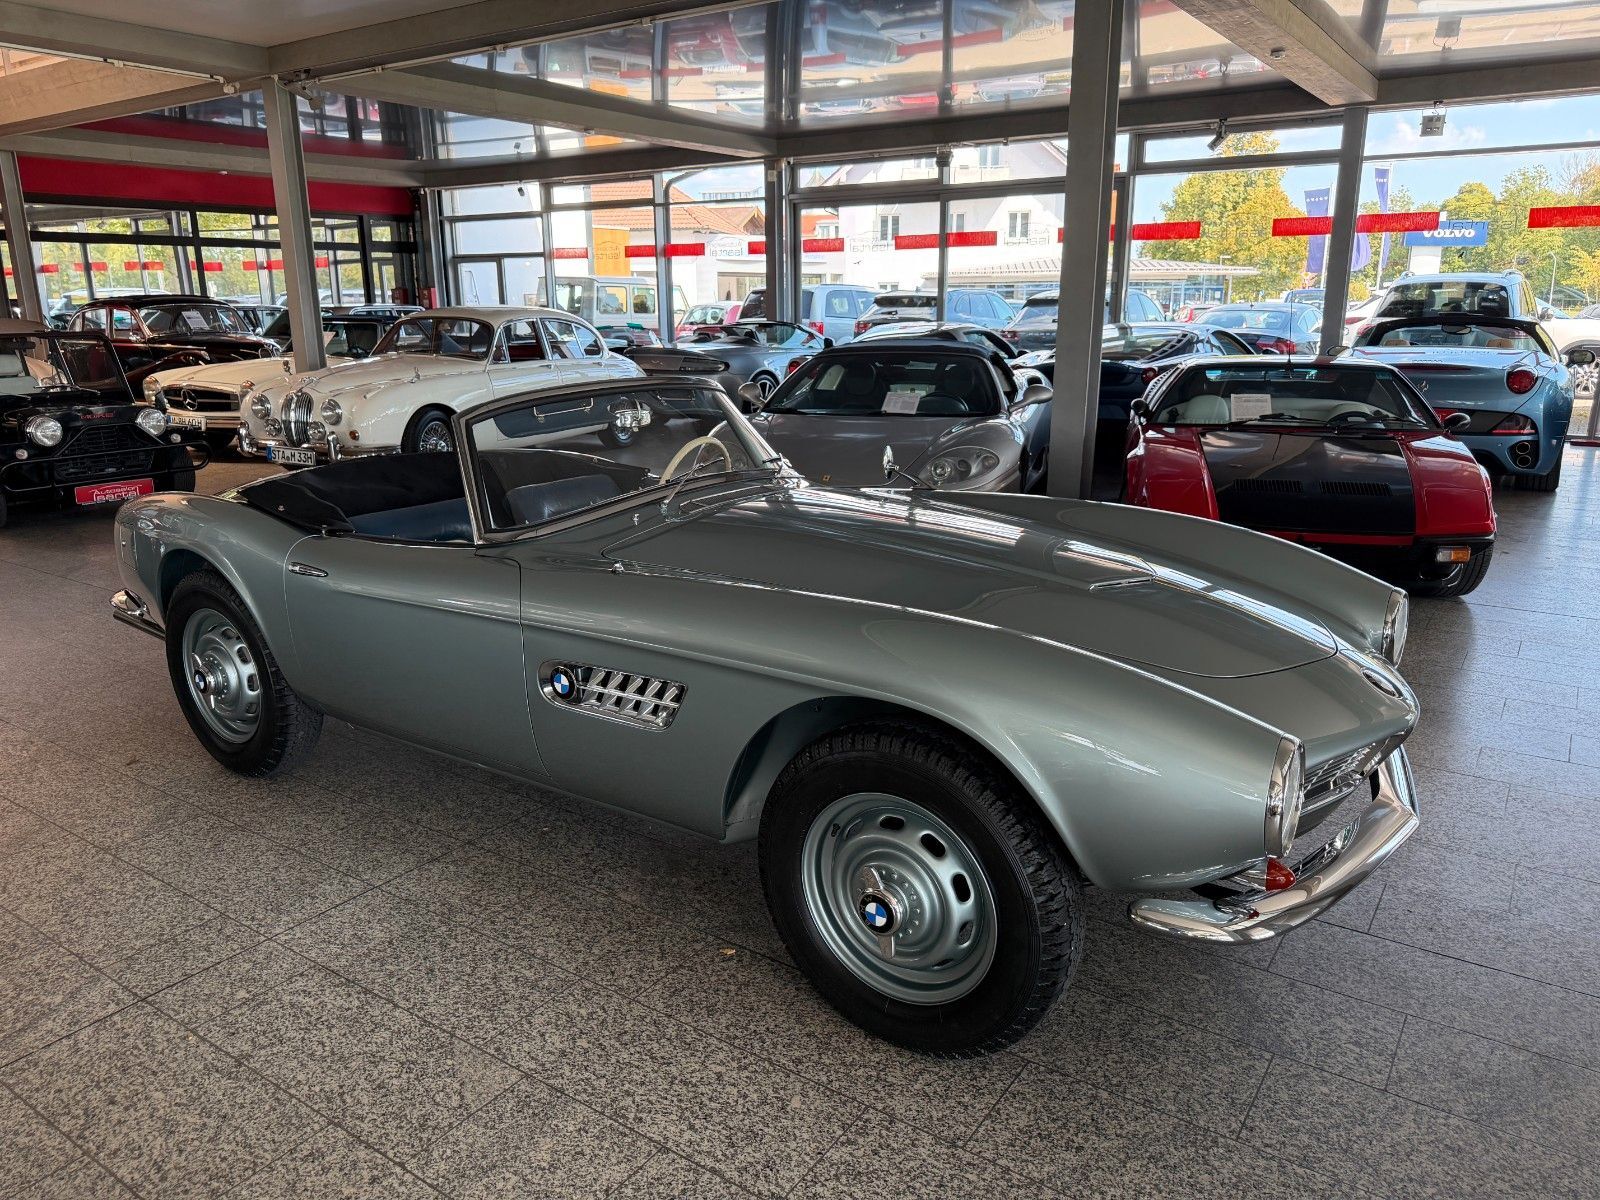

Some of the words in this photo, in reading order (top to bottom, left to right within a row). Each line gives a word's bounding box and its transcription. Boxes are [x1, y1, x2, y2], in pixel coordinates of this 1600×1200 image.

[1422, 228, 1476, 238] VOLVO
[272, 449, 286, 460] STA
[297, 452, 313, 464] 33H
